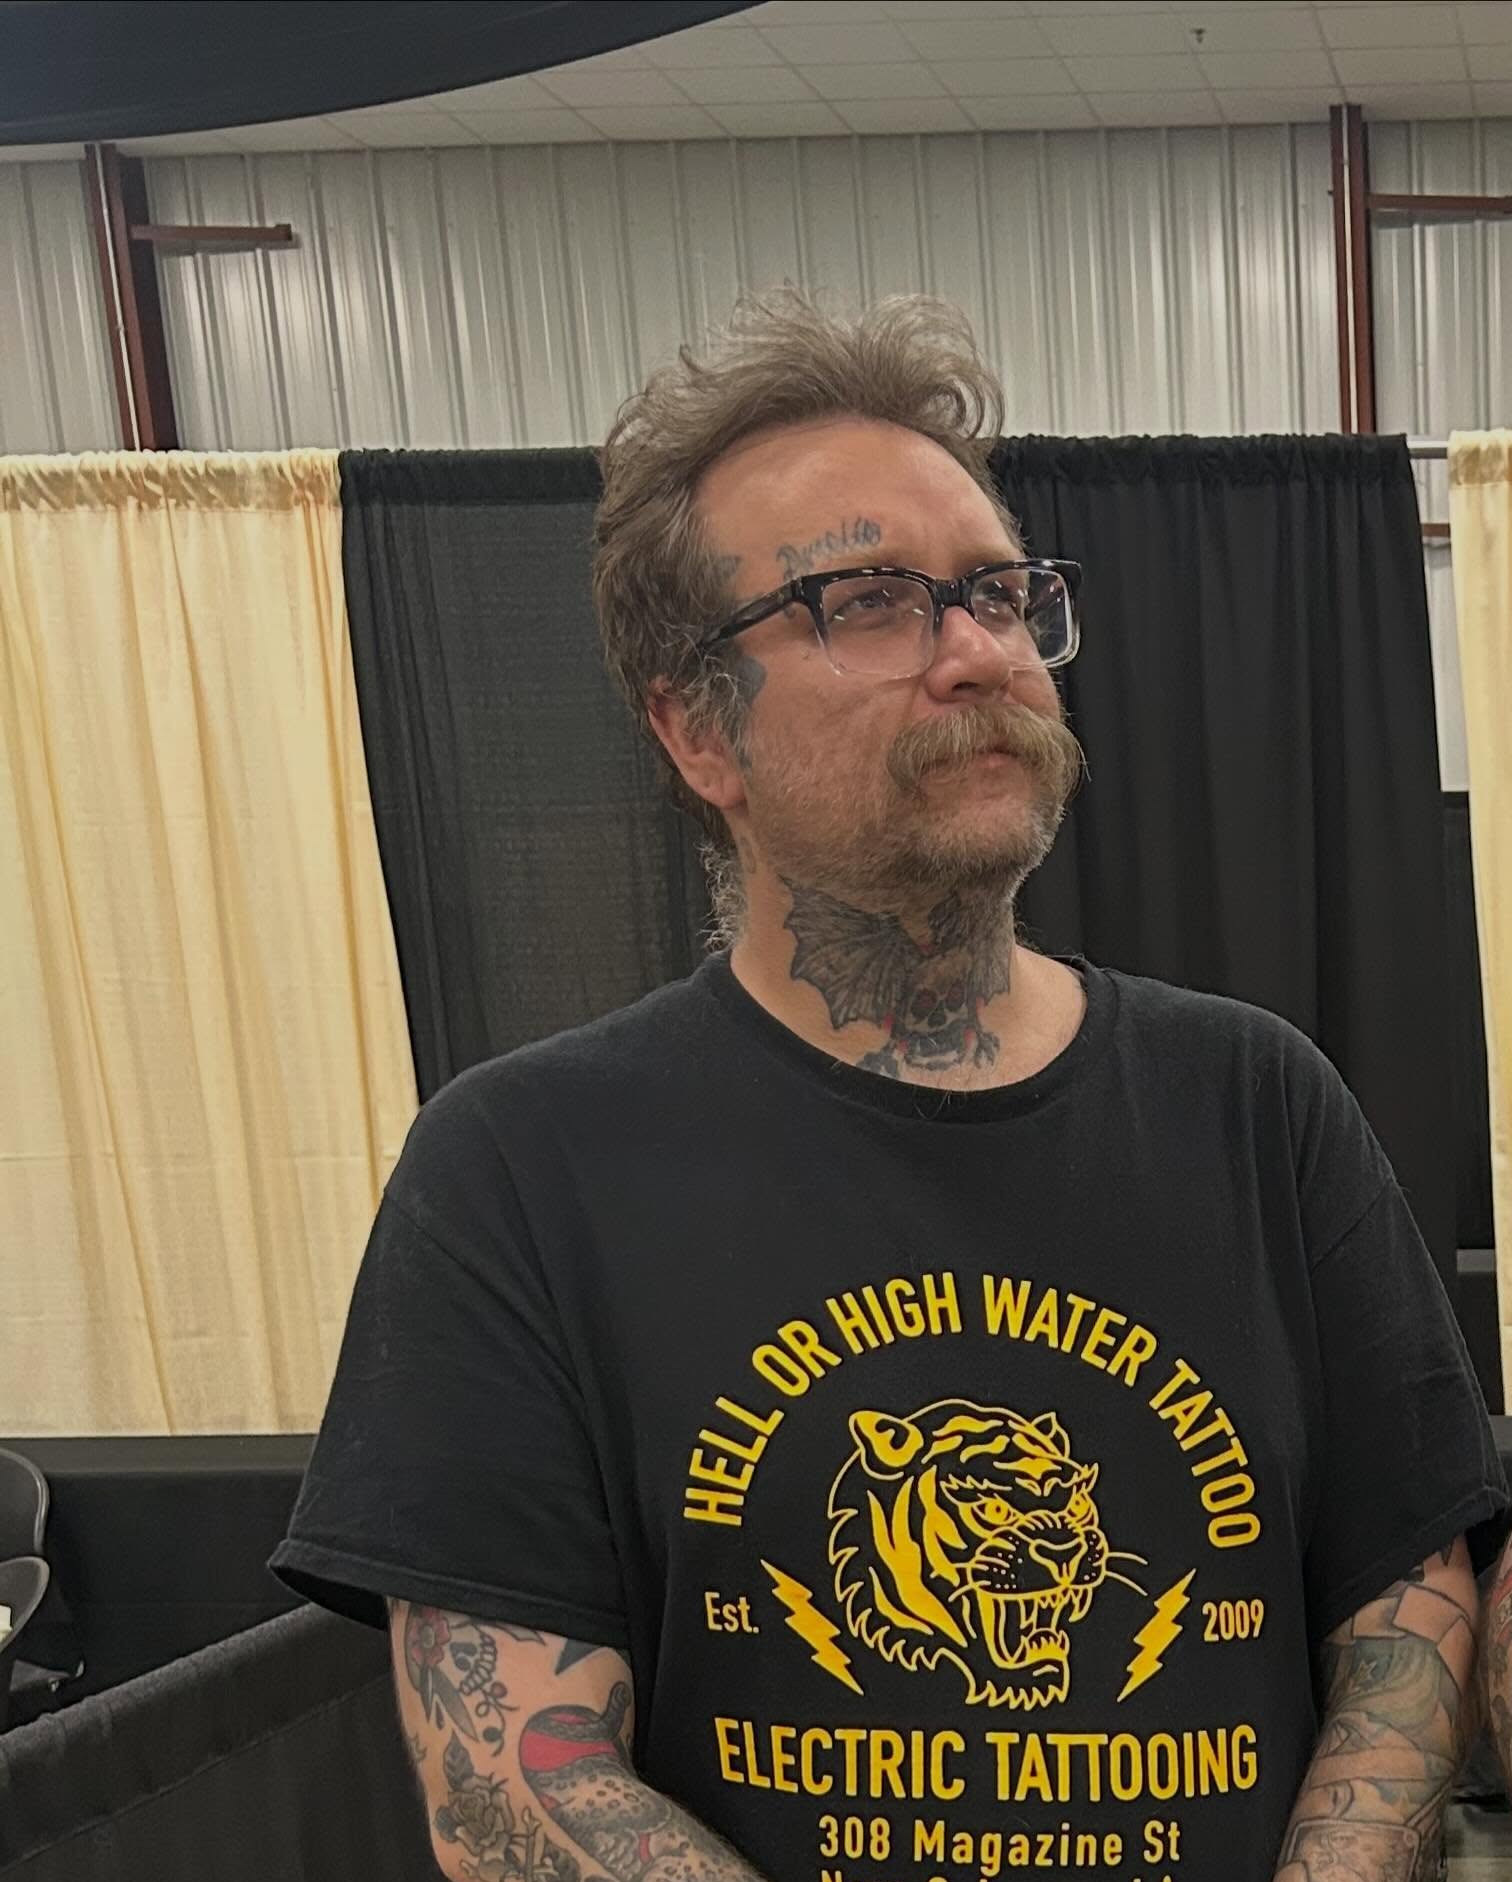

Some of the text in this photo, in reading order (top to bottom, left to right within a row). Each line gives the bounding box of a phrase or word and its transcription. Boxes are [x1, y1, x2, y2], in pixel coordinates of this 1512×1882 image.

[684, 1273, 1261, 1549] HELL OR HIGH WATER TATTOO
[704, 1591, 759, 1634] Est.
[1203, 1599, 1265, 1642] 2009
[714, 1717, 1258, 1802] ELECTRIC TATTOOING
[819, 1815, 1181, 1877] 308 Magazine St
